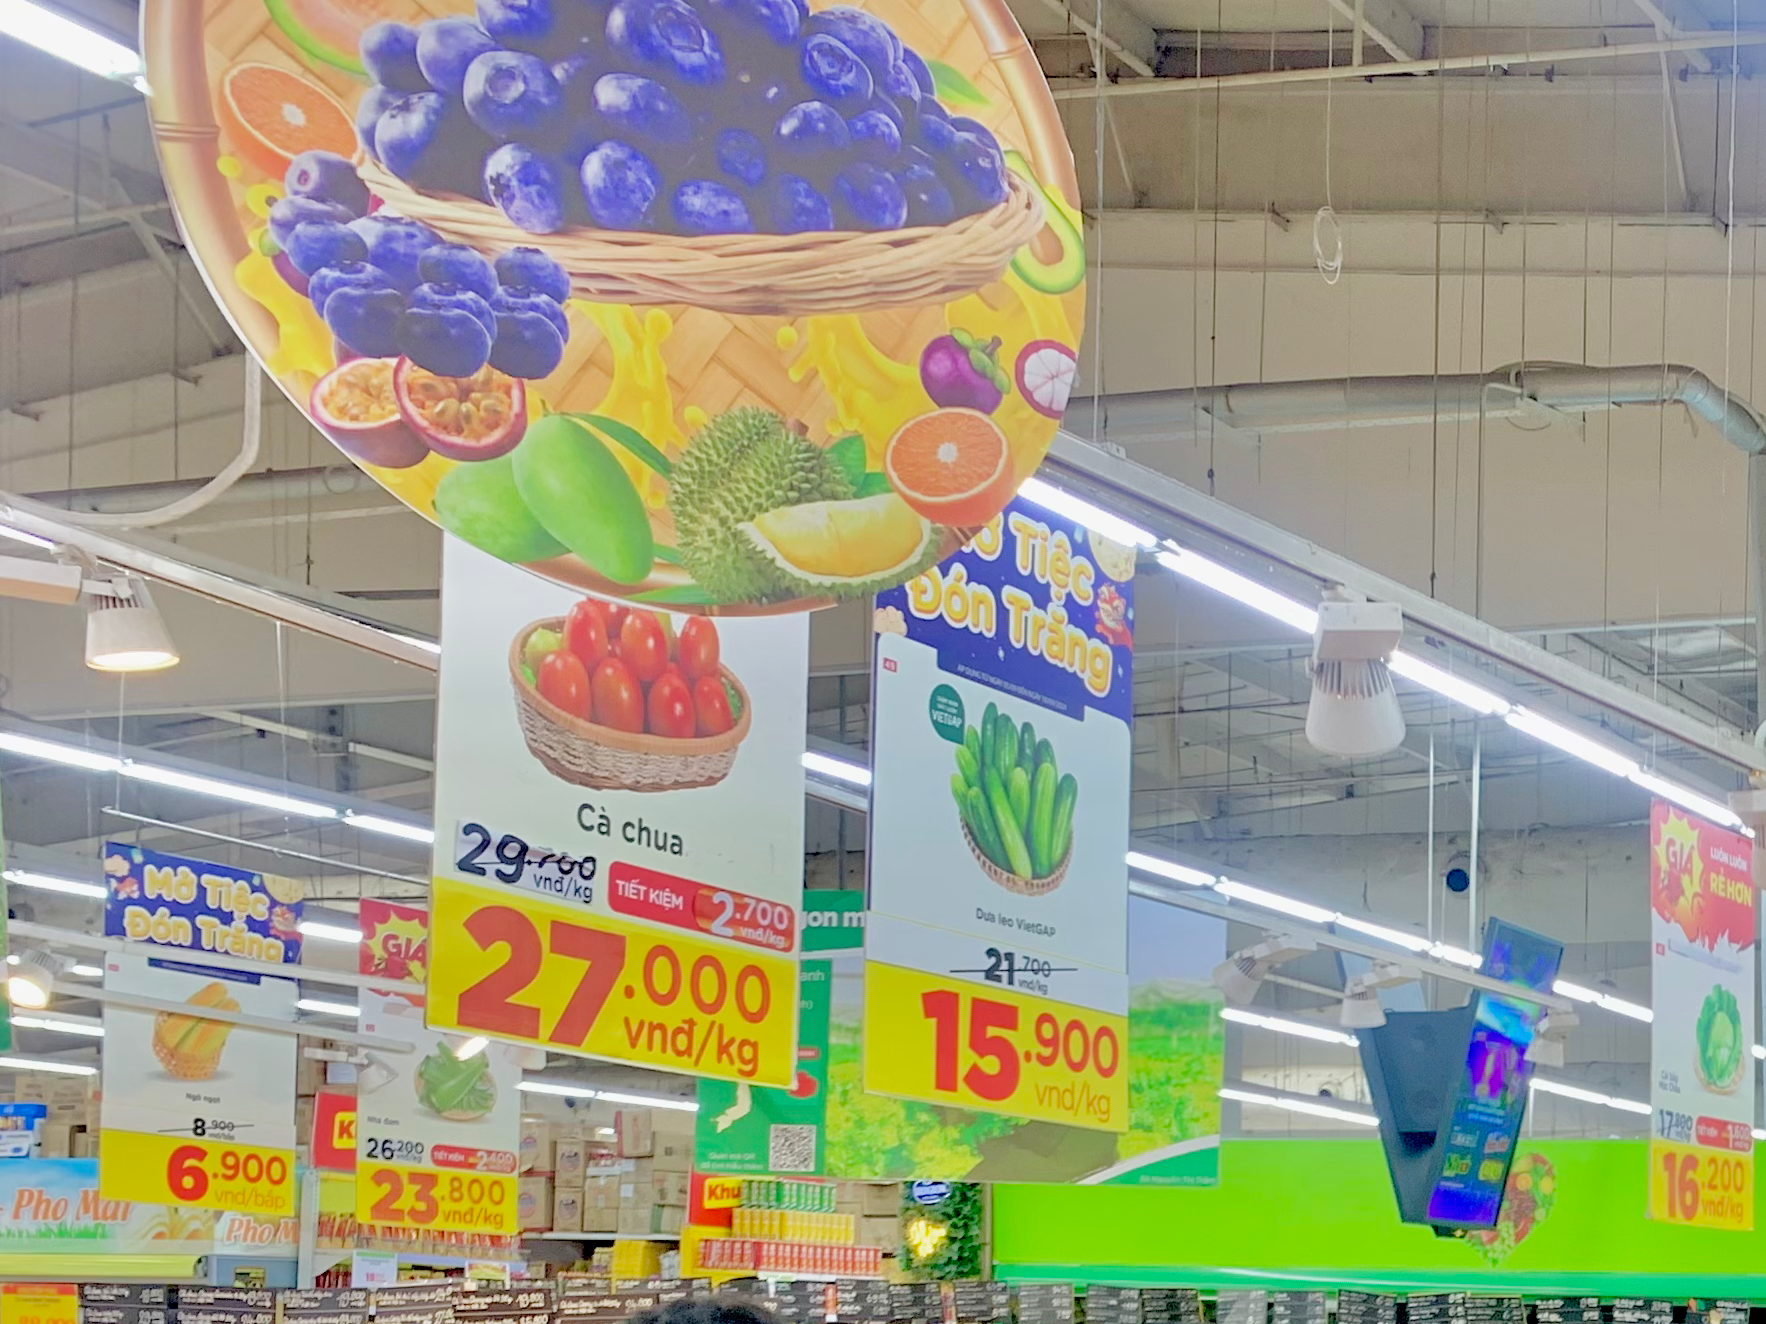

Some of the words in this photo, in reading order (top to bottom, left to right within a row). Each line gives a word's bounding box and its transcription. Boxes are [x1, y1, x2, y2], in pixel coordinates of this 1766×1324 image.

[1009, 511, 1094, 606] Tiệc
[905, 562, 996, 638] Đón
[1002, 585, 1113, 697] Trăng
[577, 803, 612, 837] Cà
[621, 817, 684, 856] chua
[144, 864, 198, 904] Mở
[200, 874, 270, 921] Tiệc
[533, 872, 593, 905] vnđ/kg
[615, 878, 647, 901] TIẾT
[649, 888, 684, 911] KIỆM
[710, 891, 789, 938] 2.700
[124, 905, 192, 946] Đón
[195, 914, 285, 963] Trăng
[976, 907, 996, 923] Dưa
[998, 913, 1014, 927] leo
[1016, 918, 1056, 937] VietGAP
[455, 905, 773, 1047] 27.000
[984, 947, 1051, 986] 21.700
[623, 1015, 760, 1077] vnđ/kg
[921, 989, 1119, 1102] 15.900
[167, 1145, 287, 1202] 6.900
[370, 1169, 506, 1225] 23.800
[1663, 1152, 1745, 1221] 16.200
[12, 1188, 69, 1221] Pho
[225, 1217, 274, 1244] Pho
